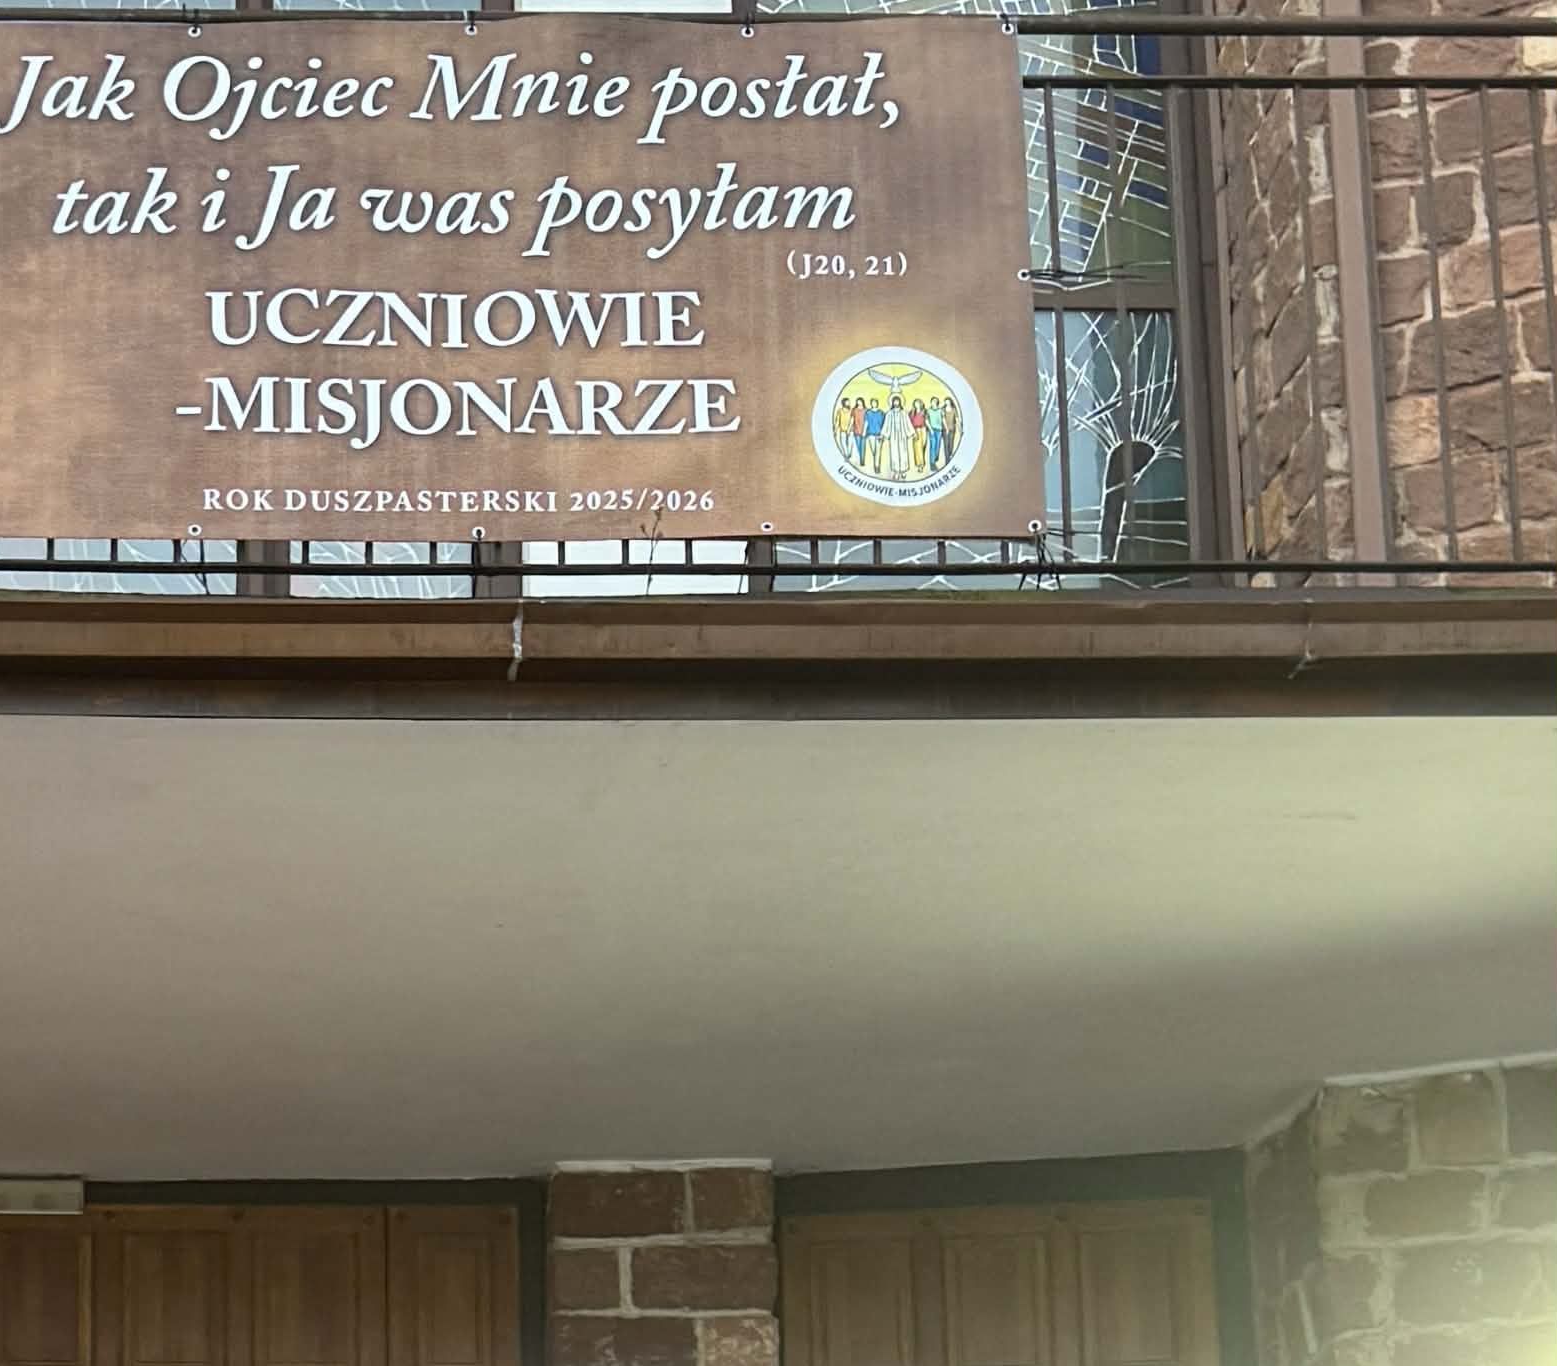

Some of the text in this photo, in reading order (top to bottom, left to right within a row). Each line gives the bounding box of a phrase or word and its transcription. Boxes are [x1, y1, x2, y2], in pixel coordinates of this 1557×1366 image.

[163, 55, 394, 141] Ojciec
[408, 52, 630, 121] Mnie
[636, 51, 899, 145] posłał,
[52, 162, 856, 259] tak i Ja was posyłam
[786, 249, 908, 280] (J20, 21)
[204, 287, 705, 348] UCZNIOWIE
[175, 376, 741, 450] -MISJONARZE
[202, 487, 715, 513] ROK DUSZPASTERSKI 2025/2026
[837, 464, 962, 497] UCZNIOWIE-MISJONARZE
